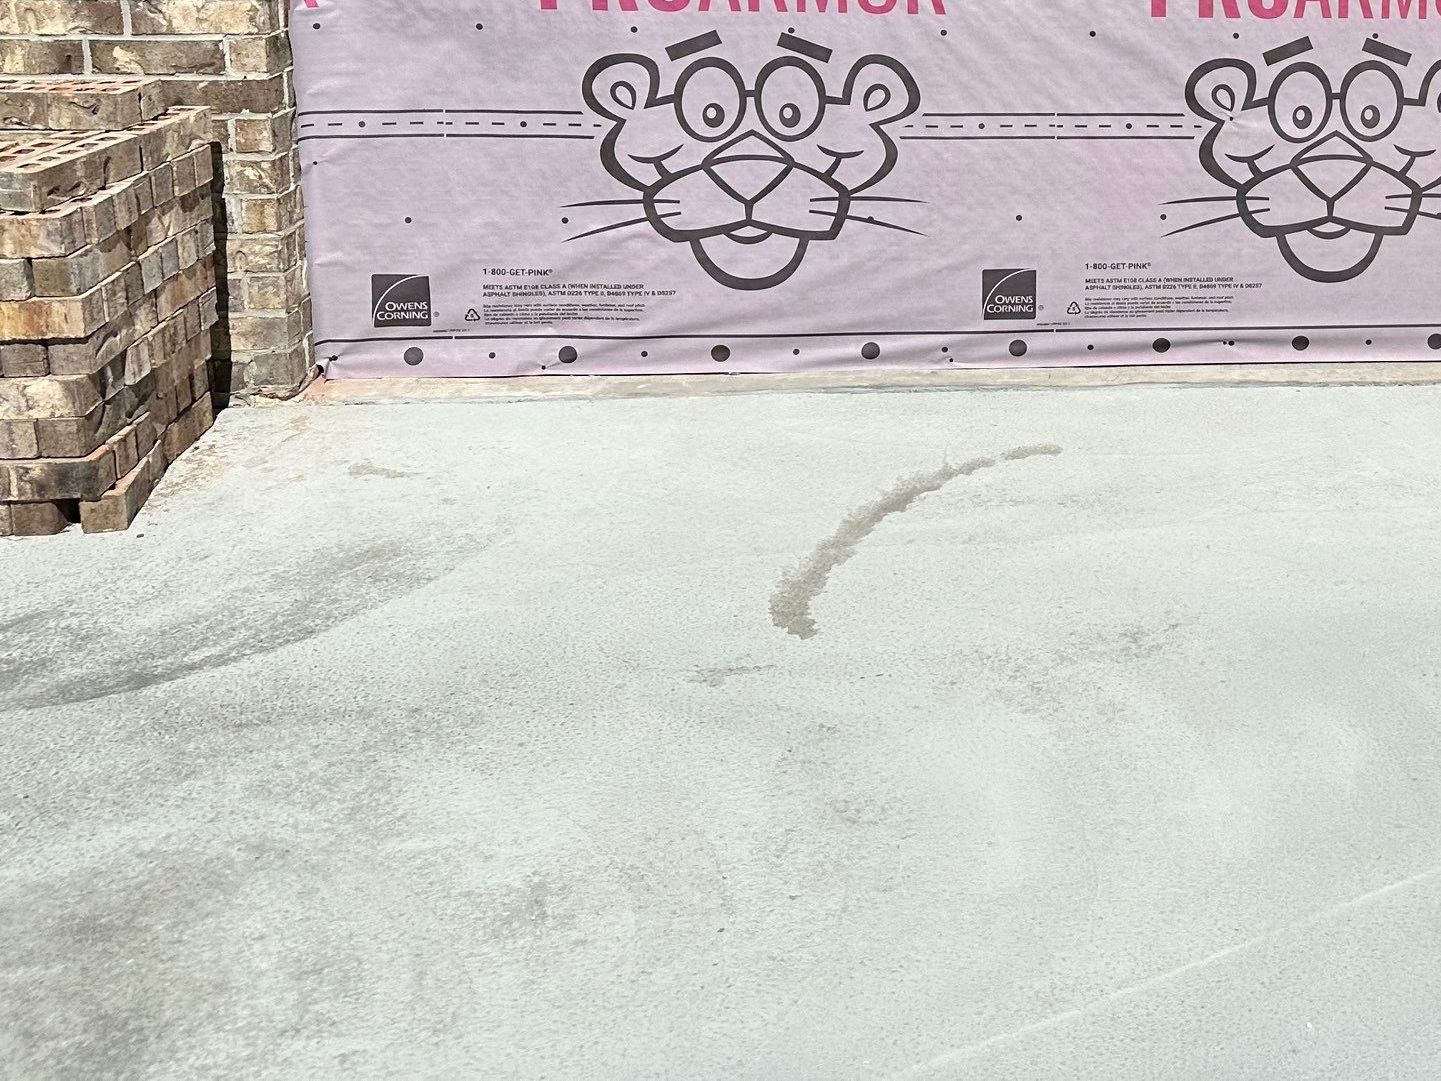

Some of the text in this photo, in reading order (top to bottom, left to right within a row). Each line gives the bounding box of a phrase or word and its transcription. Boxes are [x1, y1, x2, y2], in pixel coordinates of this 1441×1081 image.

[994, 295, 1033, 304] OWENS
[385, 301, 428, 311] OWENS
[986, 304, 1034, 313] CORNING
[376, 311, 428, 320] CORNING
